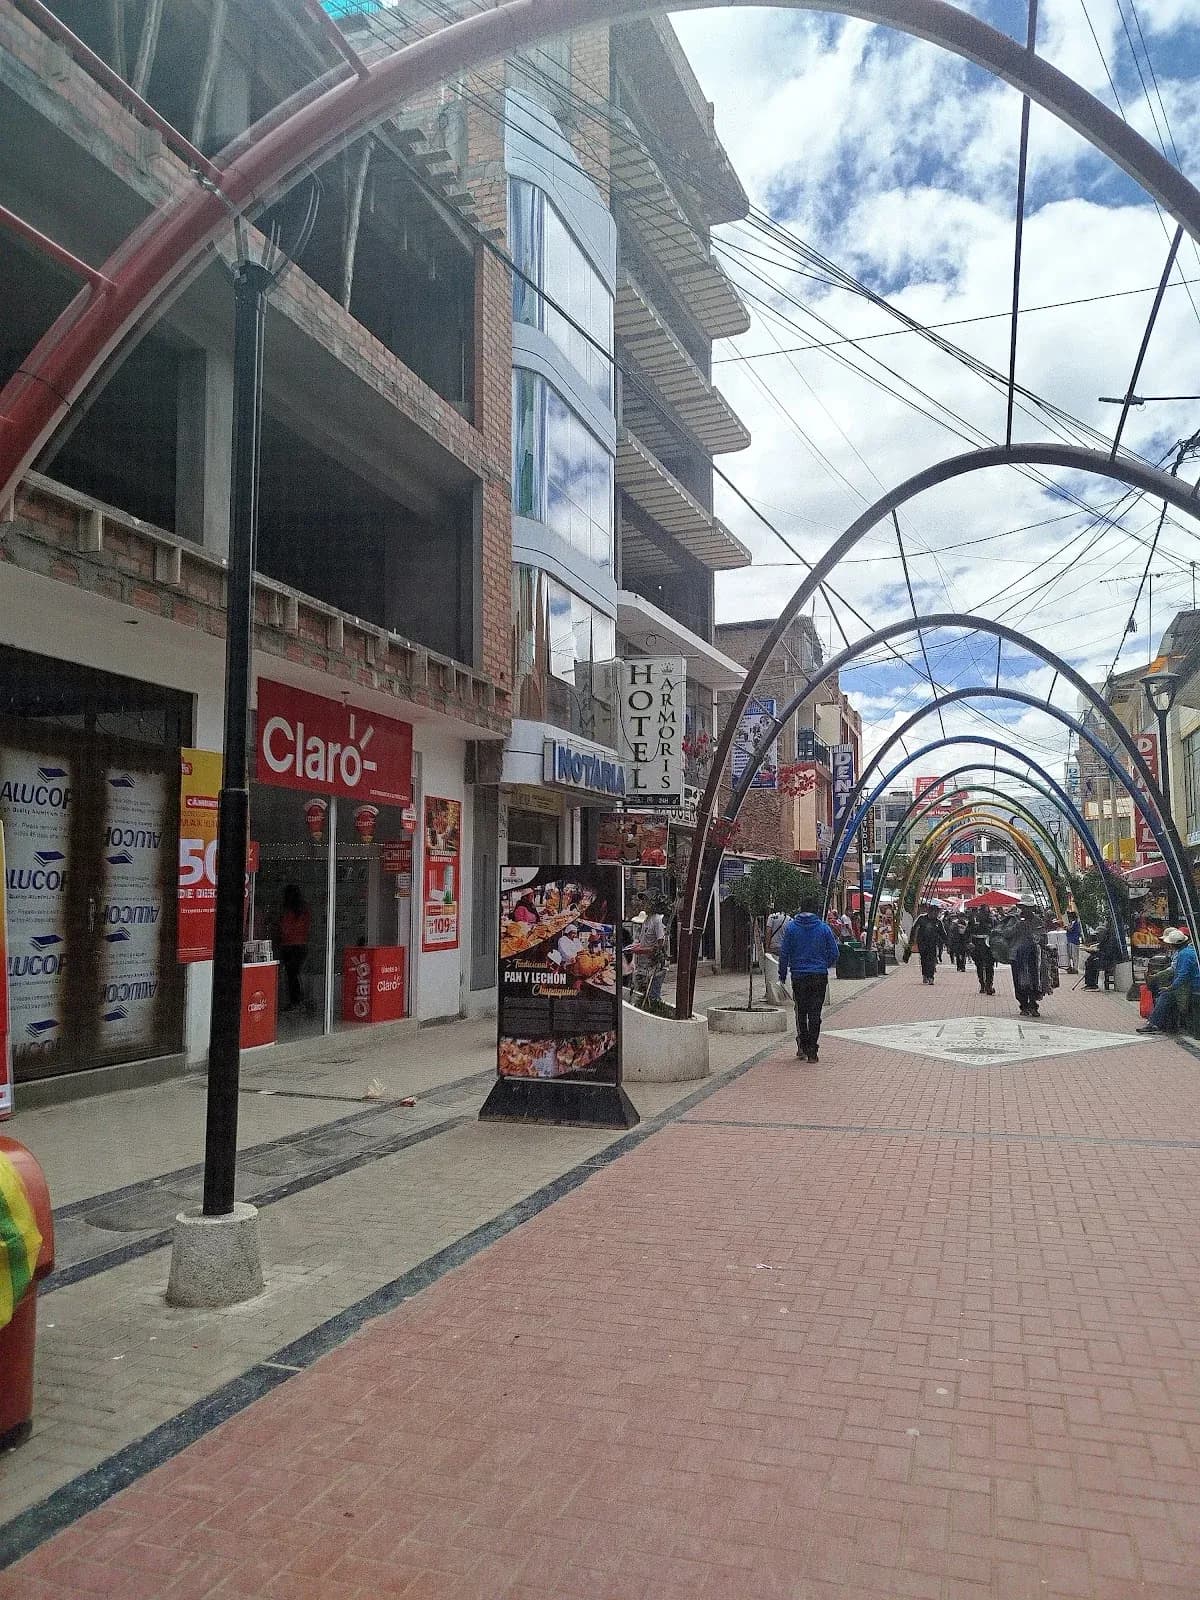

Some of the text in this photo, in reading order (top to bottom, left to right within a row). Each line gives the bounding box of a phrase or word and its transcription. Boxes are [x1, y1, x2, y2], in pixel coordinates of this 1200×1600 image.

[628, 663, 654, 789] HOTEL
[658, 677, 677, 789] ARMORIS
[262, 714, 362, 787] Claro
[6, 869, 64, 892] LUCO
[433, 917, 450, 934] 109
[504, 971, 567, 985] PAN Y LECHÓN
